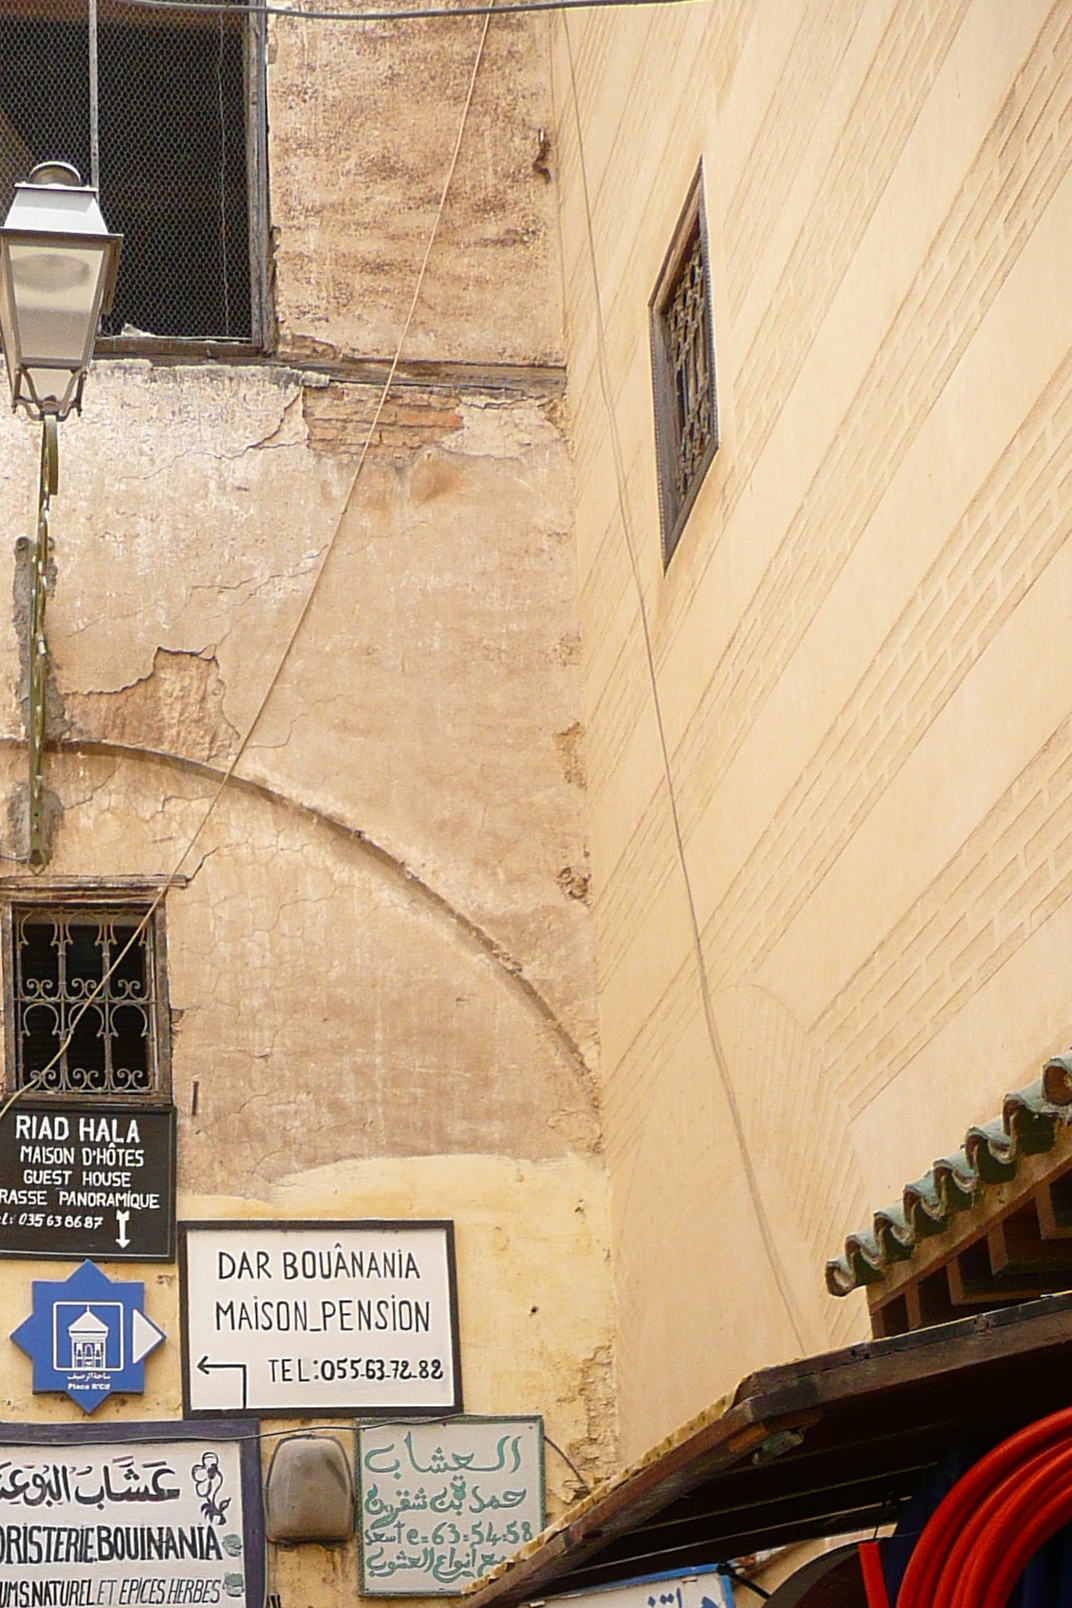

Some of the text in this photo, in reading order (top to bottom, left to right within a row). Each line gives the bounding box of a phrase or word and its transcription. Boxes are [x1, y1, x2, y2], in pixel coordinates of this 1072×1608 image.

[16, 1115, 141, 1143] RIAD HALA
[20, 1142, 144, 1167] MAISON D'HÔTES
[23, 1170, 131, 1187] GUEST HOUSE
[218, 1251, 272, 1280] DAR
[167, 1579, 221, 1604] HERBES
